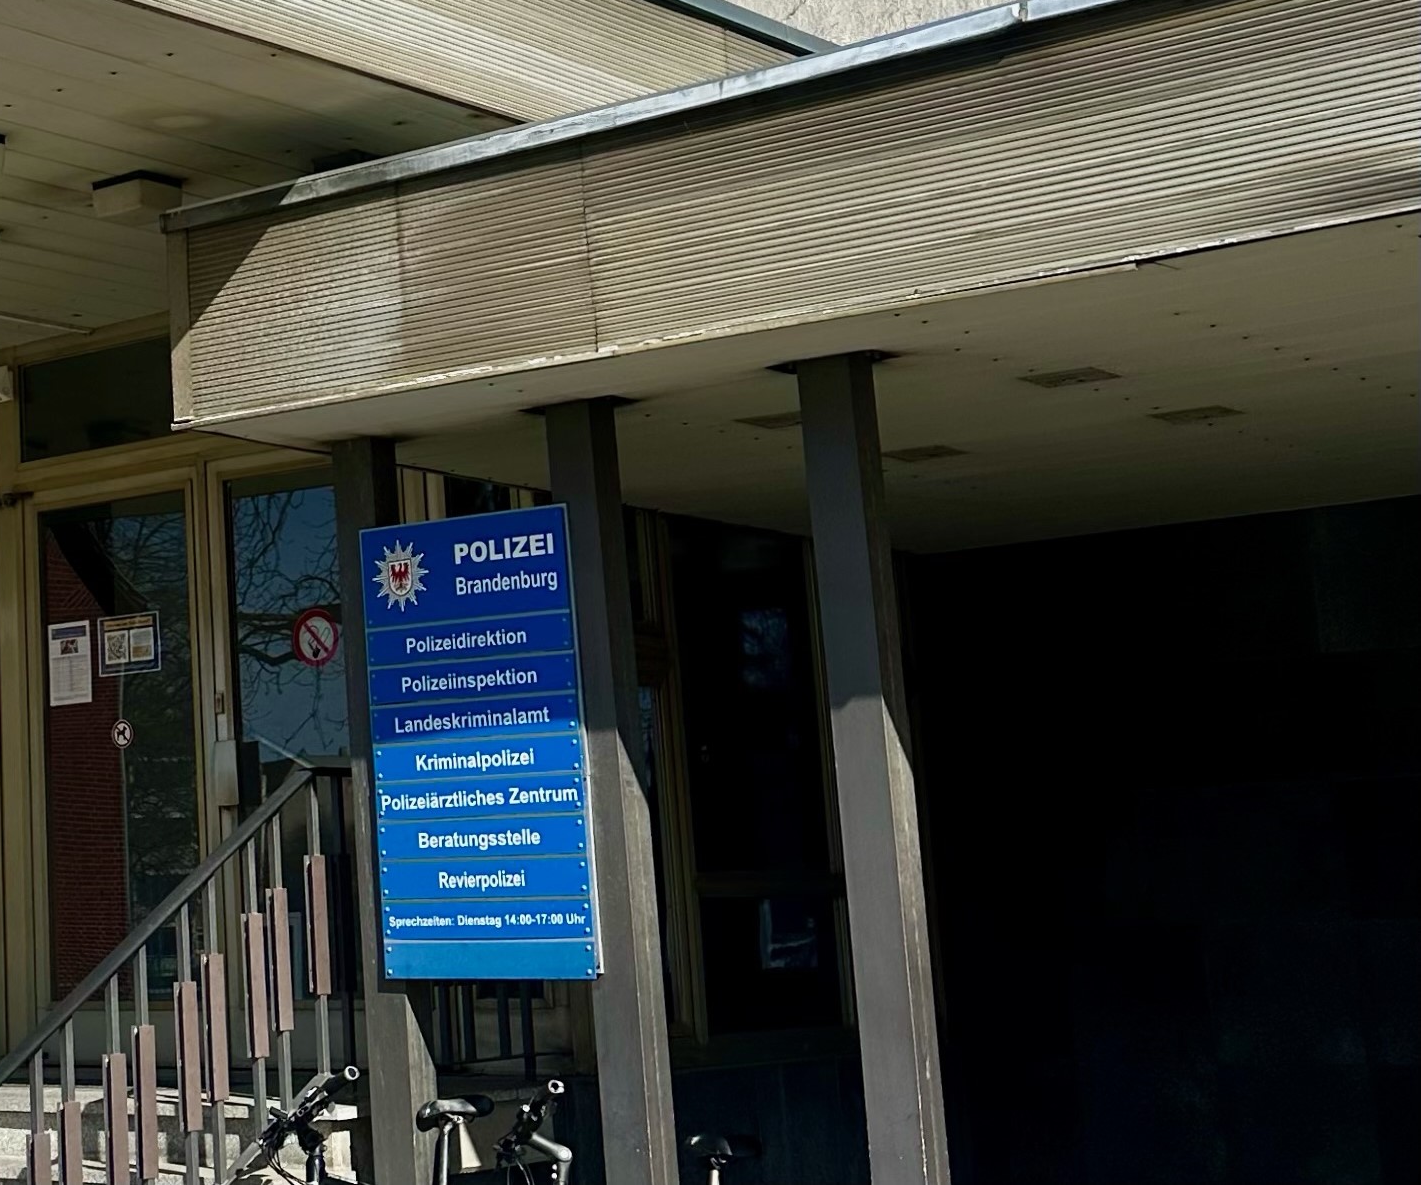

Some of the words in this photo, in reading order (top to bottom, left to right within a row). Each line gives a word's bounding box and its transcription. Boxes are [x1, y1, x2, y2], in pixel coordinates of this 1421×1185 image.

[454, 532, 555, 565] POLIZEI
[455, 570, 558, 596] Brandenburg
[406, 629, 527, 654] Polizeidirektion
[401, 668, 538, 693] Polizeiinspektion
[394, 706, 550, 733] Landeskriminalamt
[415, 748, 535, 771] Kriminalpolizei
[381, 789, 505, 811] Polizeiärztliches
[509, 787, 578, 805] Zentrum
[418, 828, 541, 850] Beratungsstelle
[438, 869, 526, 891] Revierpolizei
[389, 915, 455, 928] Sprechzeiten:
[457, 914, 502, 928] Dienstag
[504, 913, 563, 925] 14:00-17:00
[566, 913, 586, 925] Uhr
